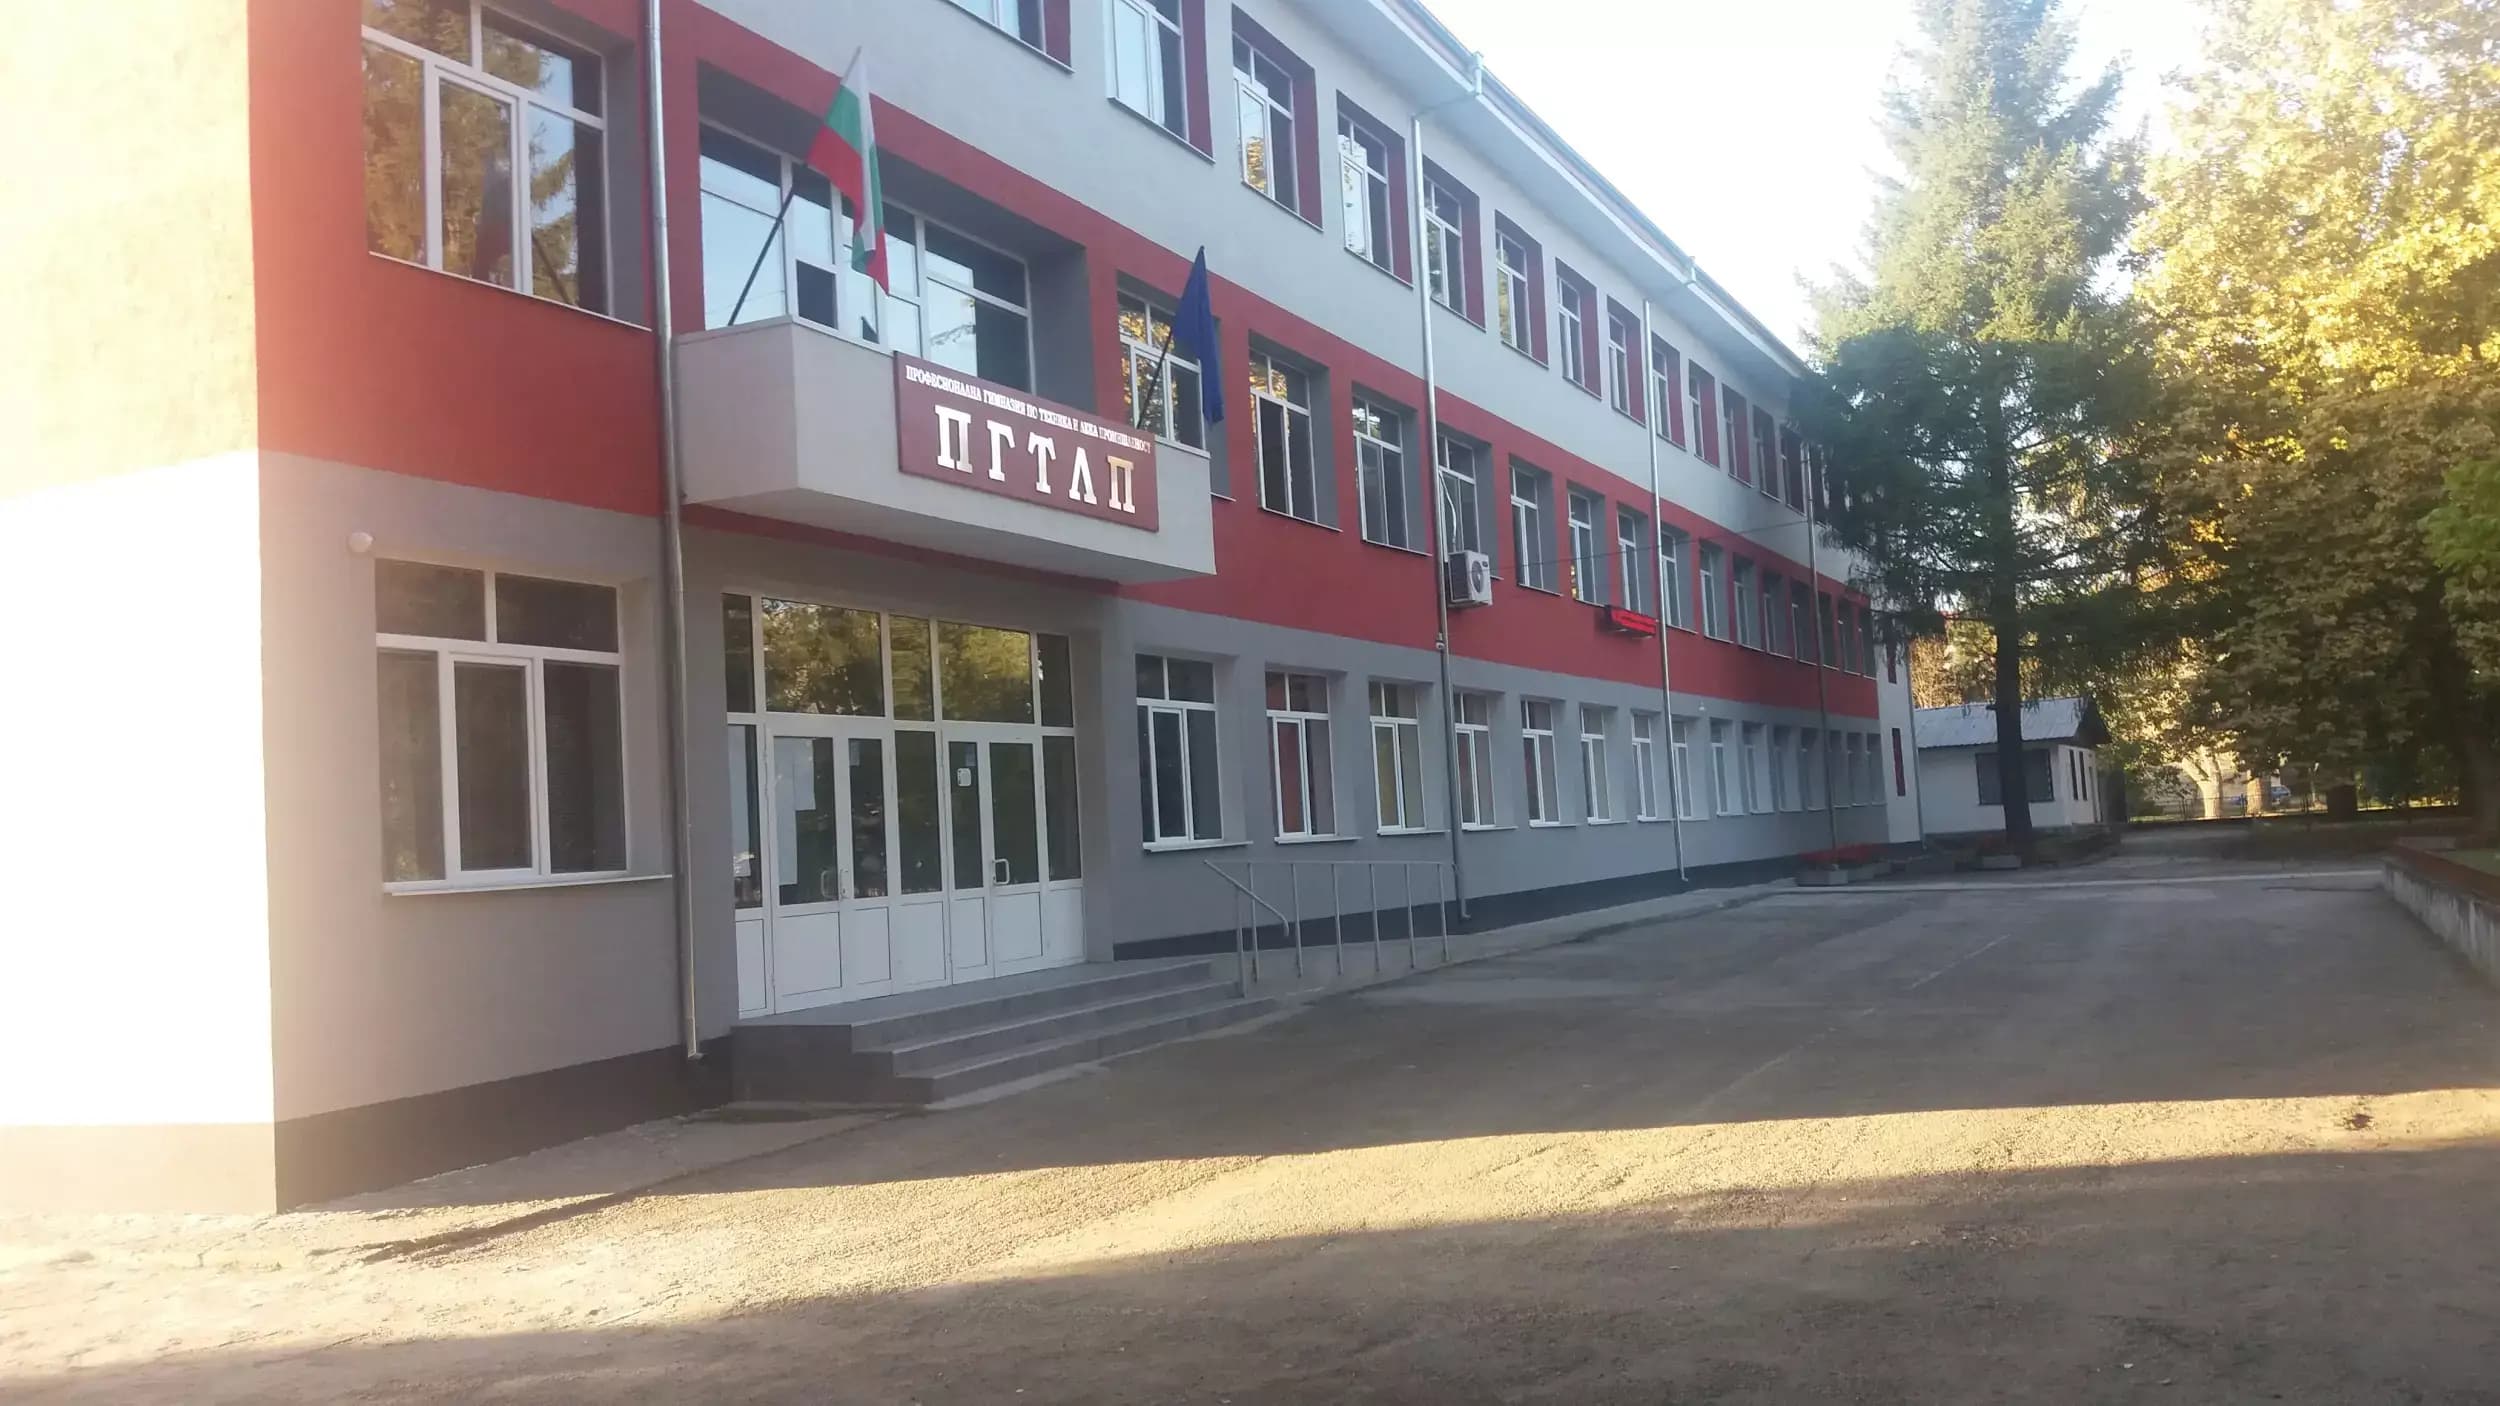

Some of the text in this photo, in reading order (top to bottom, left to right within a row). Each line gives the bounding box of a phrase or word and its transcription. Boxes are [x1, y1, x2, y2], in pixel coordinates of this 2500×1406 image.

[905, 364, 982, 401] ПРОФЕСИОНАЛНА
[983, 389, 1026, 416] ГИМНАЗИЯ
[1026, 403, 1038, 420] ПО
[1072, 418, 1079, 432] И
[934, 404, 1135, 513] ПГТЛП
